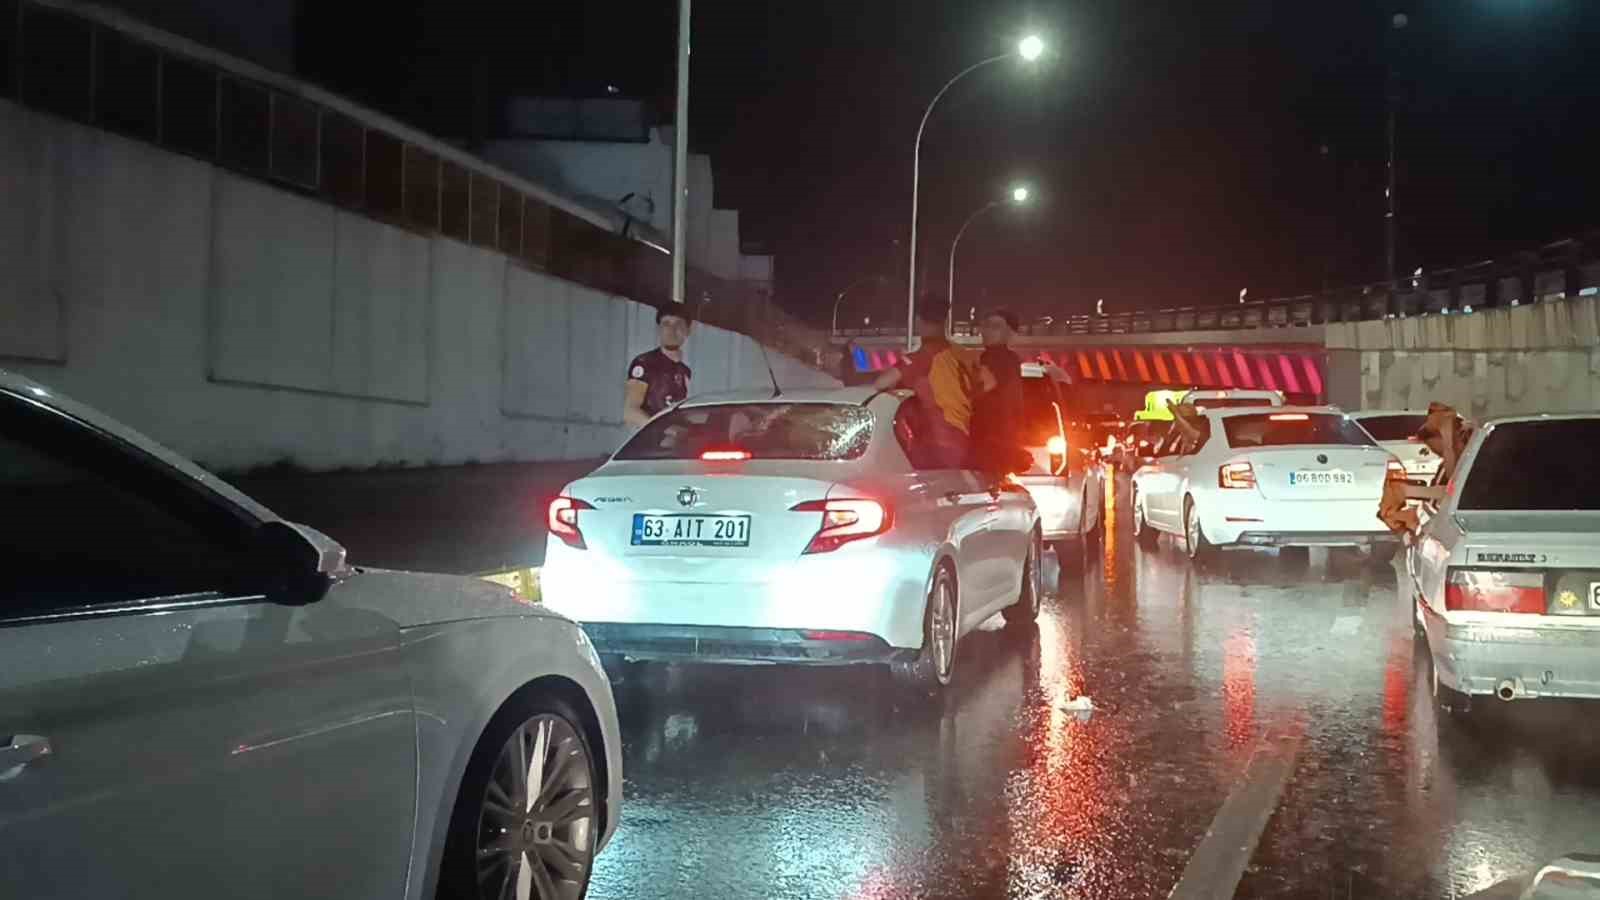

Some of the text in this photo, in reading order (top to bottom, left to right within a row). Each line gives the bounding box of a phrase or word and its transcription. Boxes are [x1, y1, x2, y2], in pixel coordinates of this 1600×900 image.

[644, 519, 745, 539] 63 AIT 201
